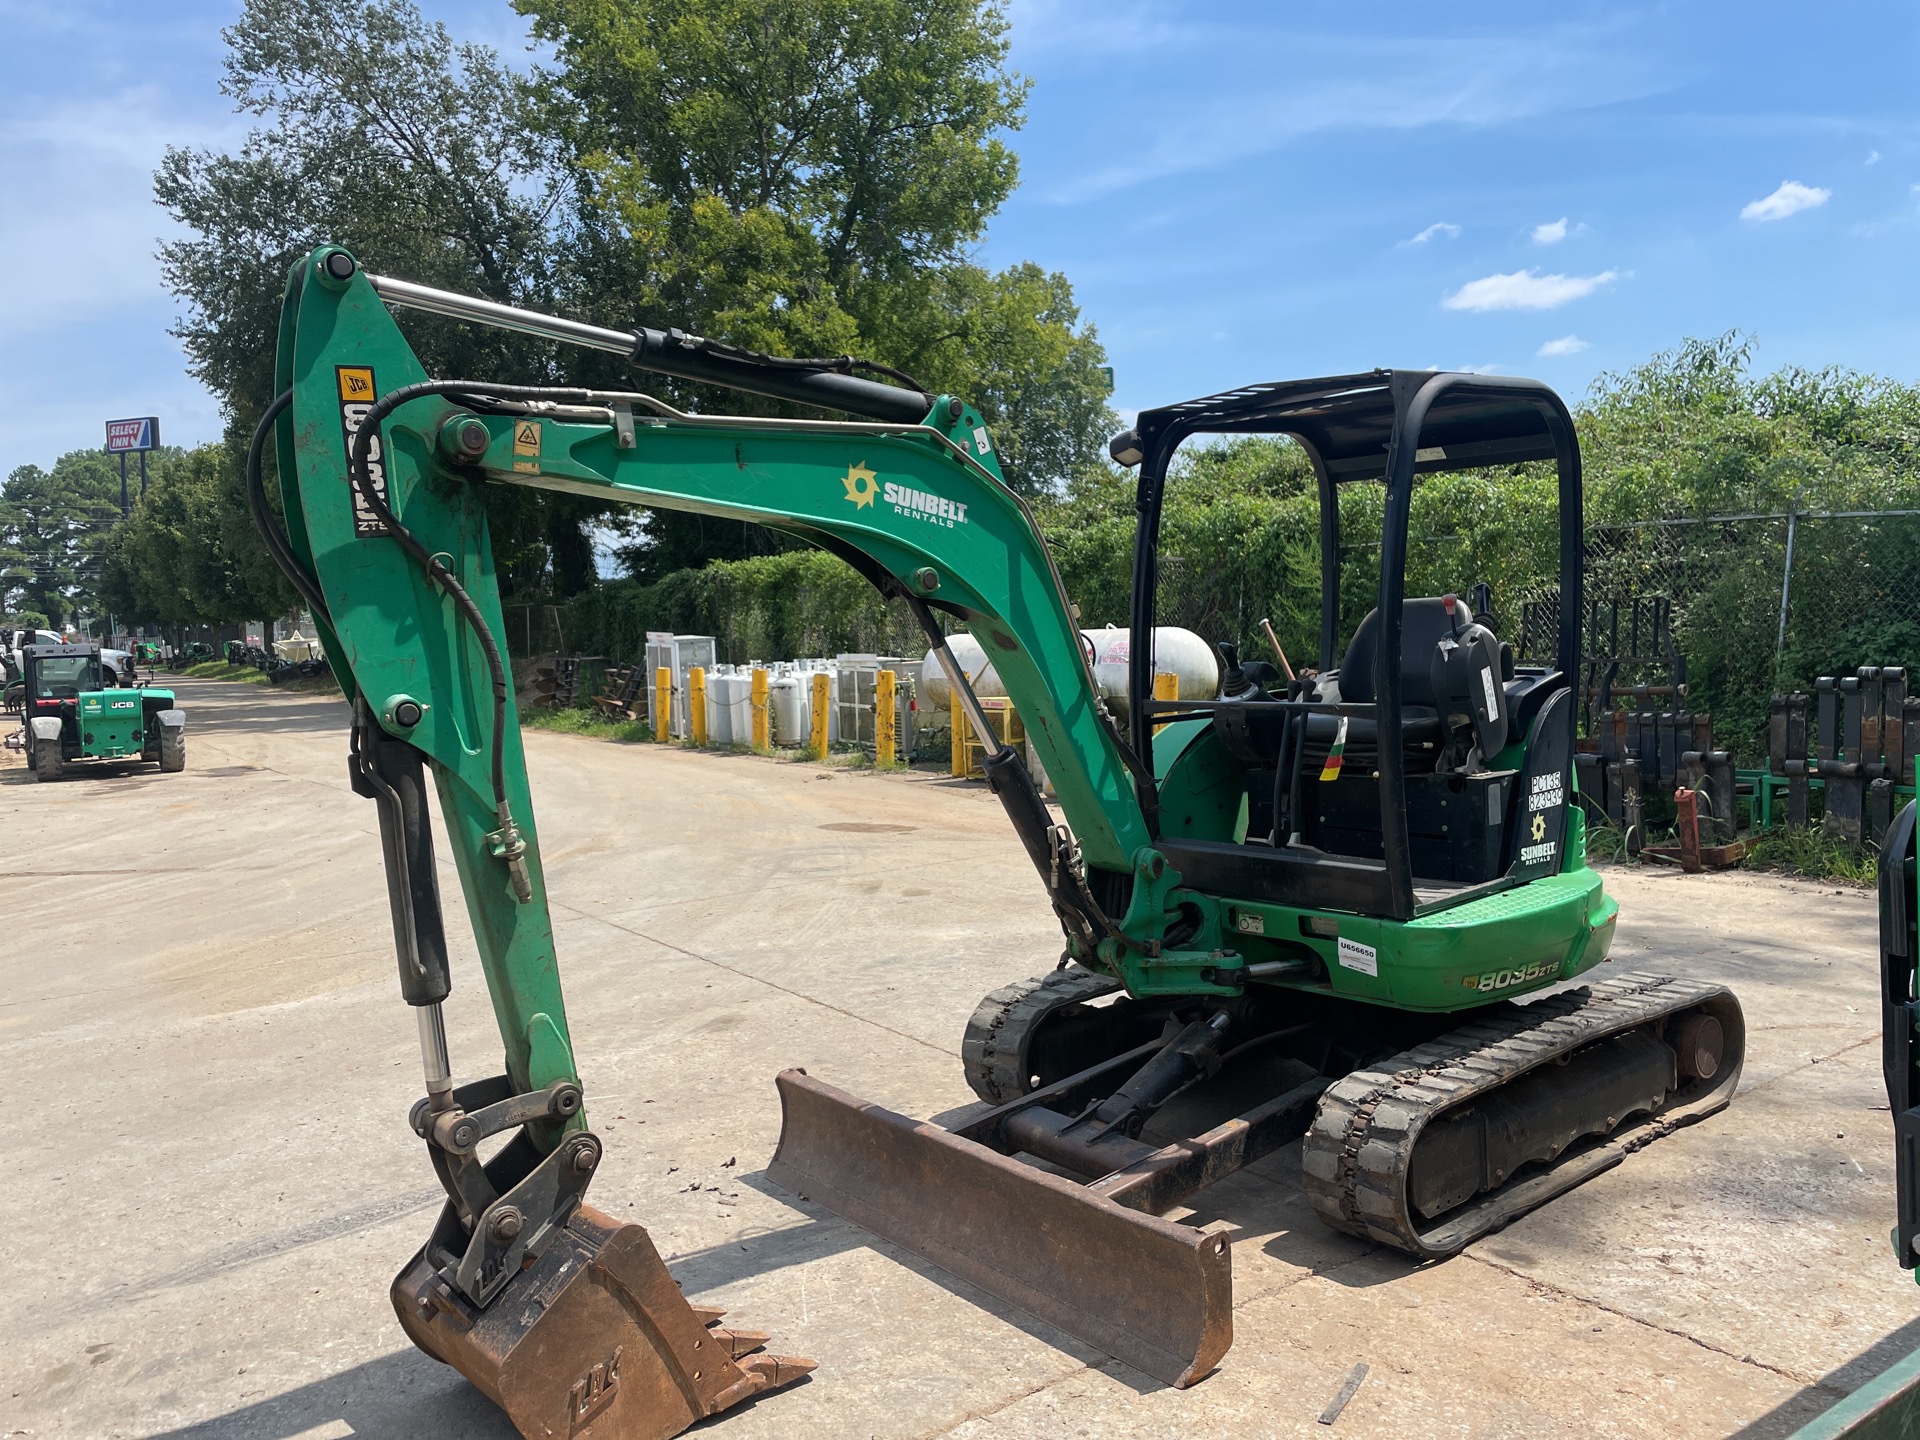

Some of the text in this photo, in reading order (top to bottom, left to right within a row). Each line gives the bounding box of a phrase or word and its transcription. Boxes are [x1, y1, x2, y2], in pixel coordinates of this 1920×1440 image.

[349, 377, 369, 392] JCB
[110, 424, 139, 437] SELECT
[112, 437, 129, 447] INN
[883, 482, 968, 523] SUNBELT
[894, 506, 954, 528] RENTALS
[1532, 772, 1560, 793] PC135
[1529, 788, 1563, 811] 823939
[1521, 842, 1556, 861] SUNBELT
[1525, 855, 1551, 866] RENTALS
[1341, 942, 1374, 957] U656650
[1478, 961, 1541, 992] 8035
[1539, 961, 1560, 976] ZTS
